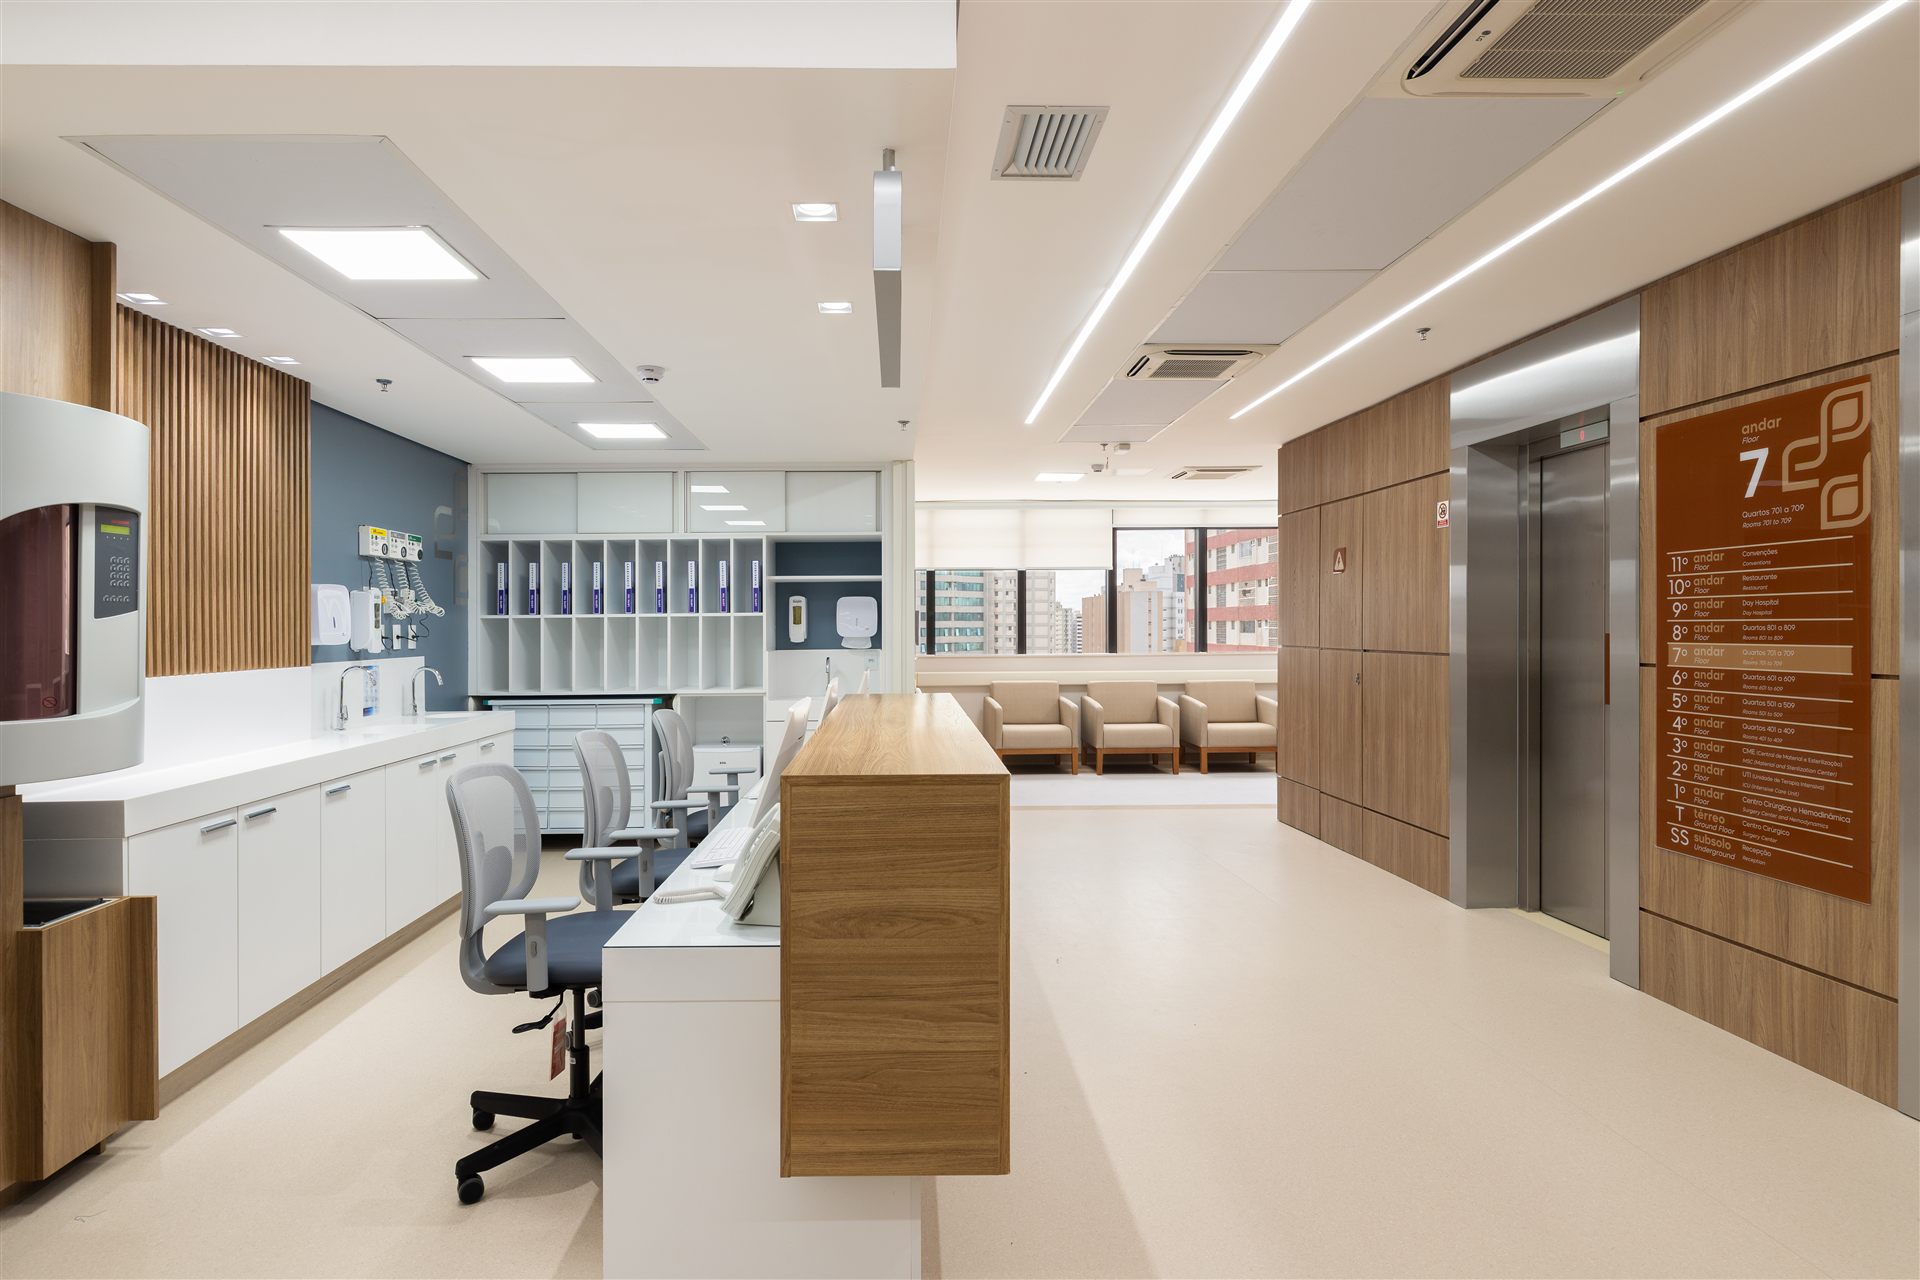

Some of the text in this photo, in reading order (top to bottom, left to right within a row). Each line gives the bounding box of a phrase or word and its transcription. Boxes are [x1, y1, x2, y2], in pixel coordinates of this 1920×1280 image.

[1741, 417, 1782, 435] andar
[1742, 435, 1760, 445] Floor
[1739, 447, 1769, 499] 7
[1742, 509, 1770, 519] Quartos
[1771, 506, 1783, 515] 701
[1791, 503, 1805, 512] 709
[1742, 517, 1793, 529] Rooms 701 to 709
[1742, 549, 1778, 557] Convenções
[1671, 551, 1725, 573] 11º andar
[1742, 573, 1777, 581] Restaurante
[1669, 575, 1725, 595] 10º andar
[1672, 599, 1725, 618] 9º andar
[1694, 610, 1710, 618] Floor
[1672, 622, 1725, 641] 8º andar
[1694, 633, 1710, 641] Floor
[1672, 646, 1725, 663] 7º andar
[1694, 657, 1710, 665] Floor
[1672, 669, 1725, 685] 6º andar
[1694, 680, 1710, 688] Floor
[1672, 692, 1725, 709] 5º andar
[1694, 703, 1710, 711] Floor
[1742, 698, 1766, 706] Quartos
[1672, 715, 1725, 732] 4º andar
[1742, 723, 1766, 731] Quartos
[1783, 727, 1796, 735] 409
[1694, 727, 1710, 736] Floor
[1672, 737, 1725, 754] 3º andar
[1694, 750, 1710, 759] Floor
[1672, 760, 1725, 777] 2º andar
[1694, 772, 1710, 782] Floor
[1674, 783, 1725, 801] 1º andar
[1694, 796, 1710, 806] Floor
[1742, 796, 1763, 807] Centro
[1675, 805, 1726, 825] T térreo
[1693, 819, 1735, 836] Ground Floor
[1742, 820, 1763, 831] Centro
[1670, 827, 1732, 850] SS subsolo
[1693, 843, 1736, 861] Underground
[1742, 843, 1772, 858] Recepção
[1742, 855, 1766, 866] Reception
